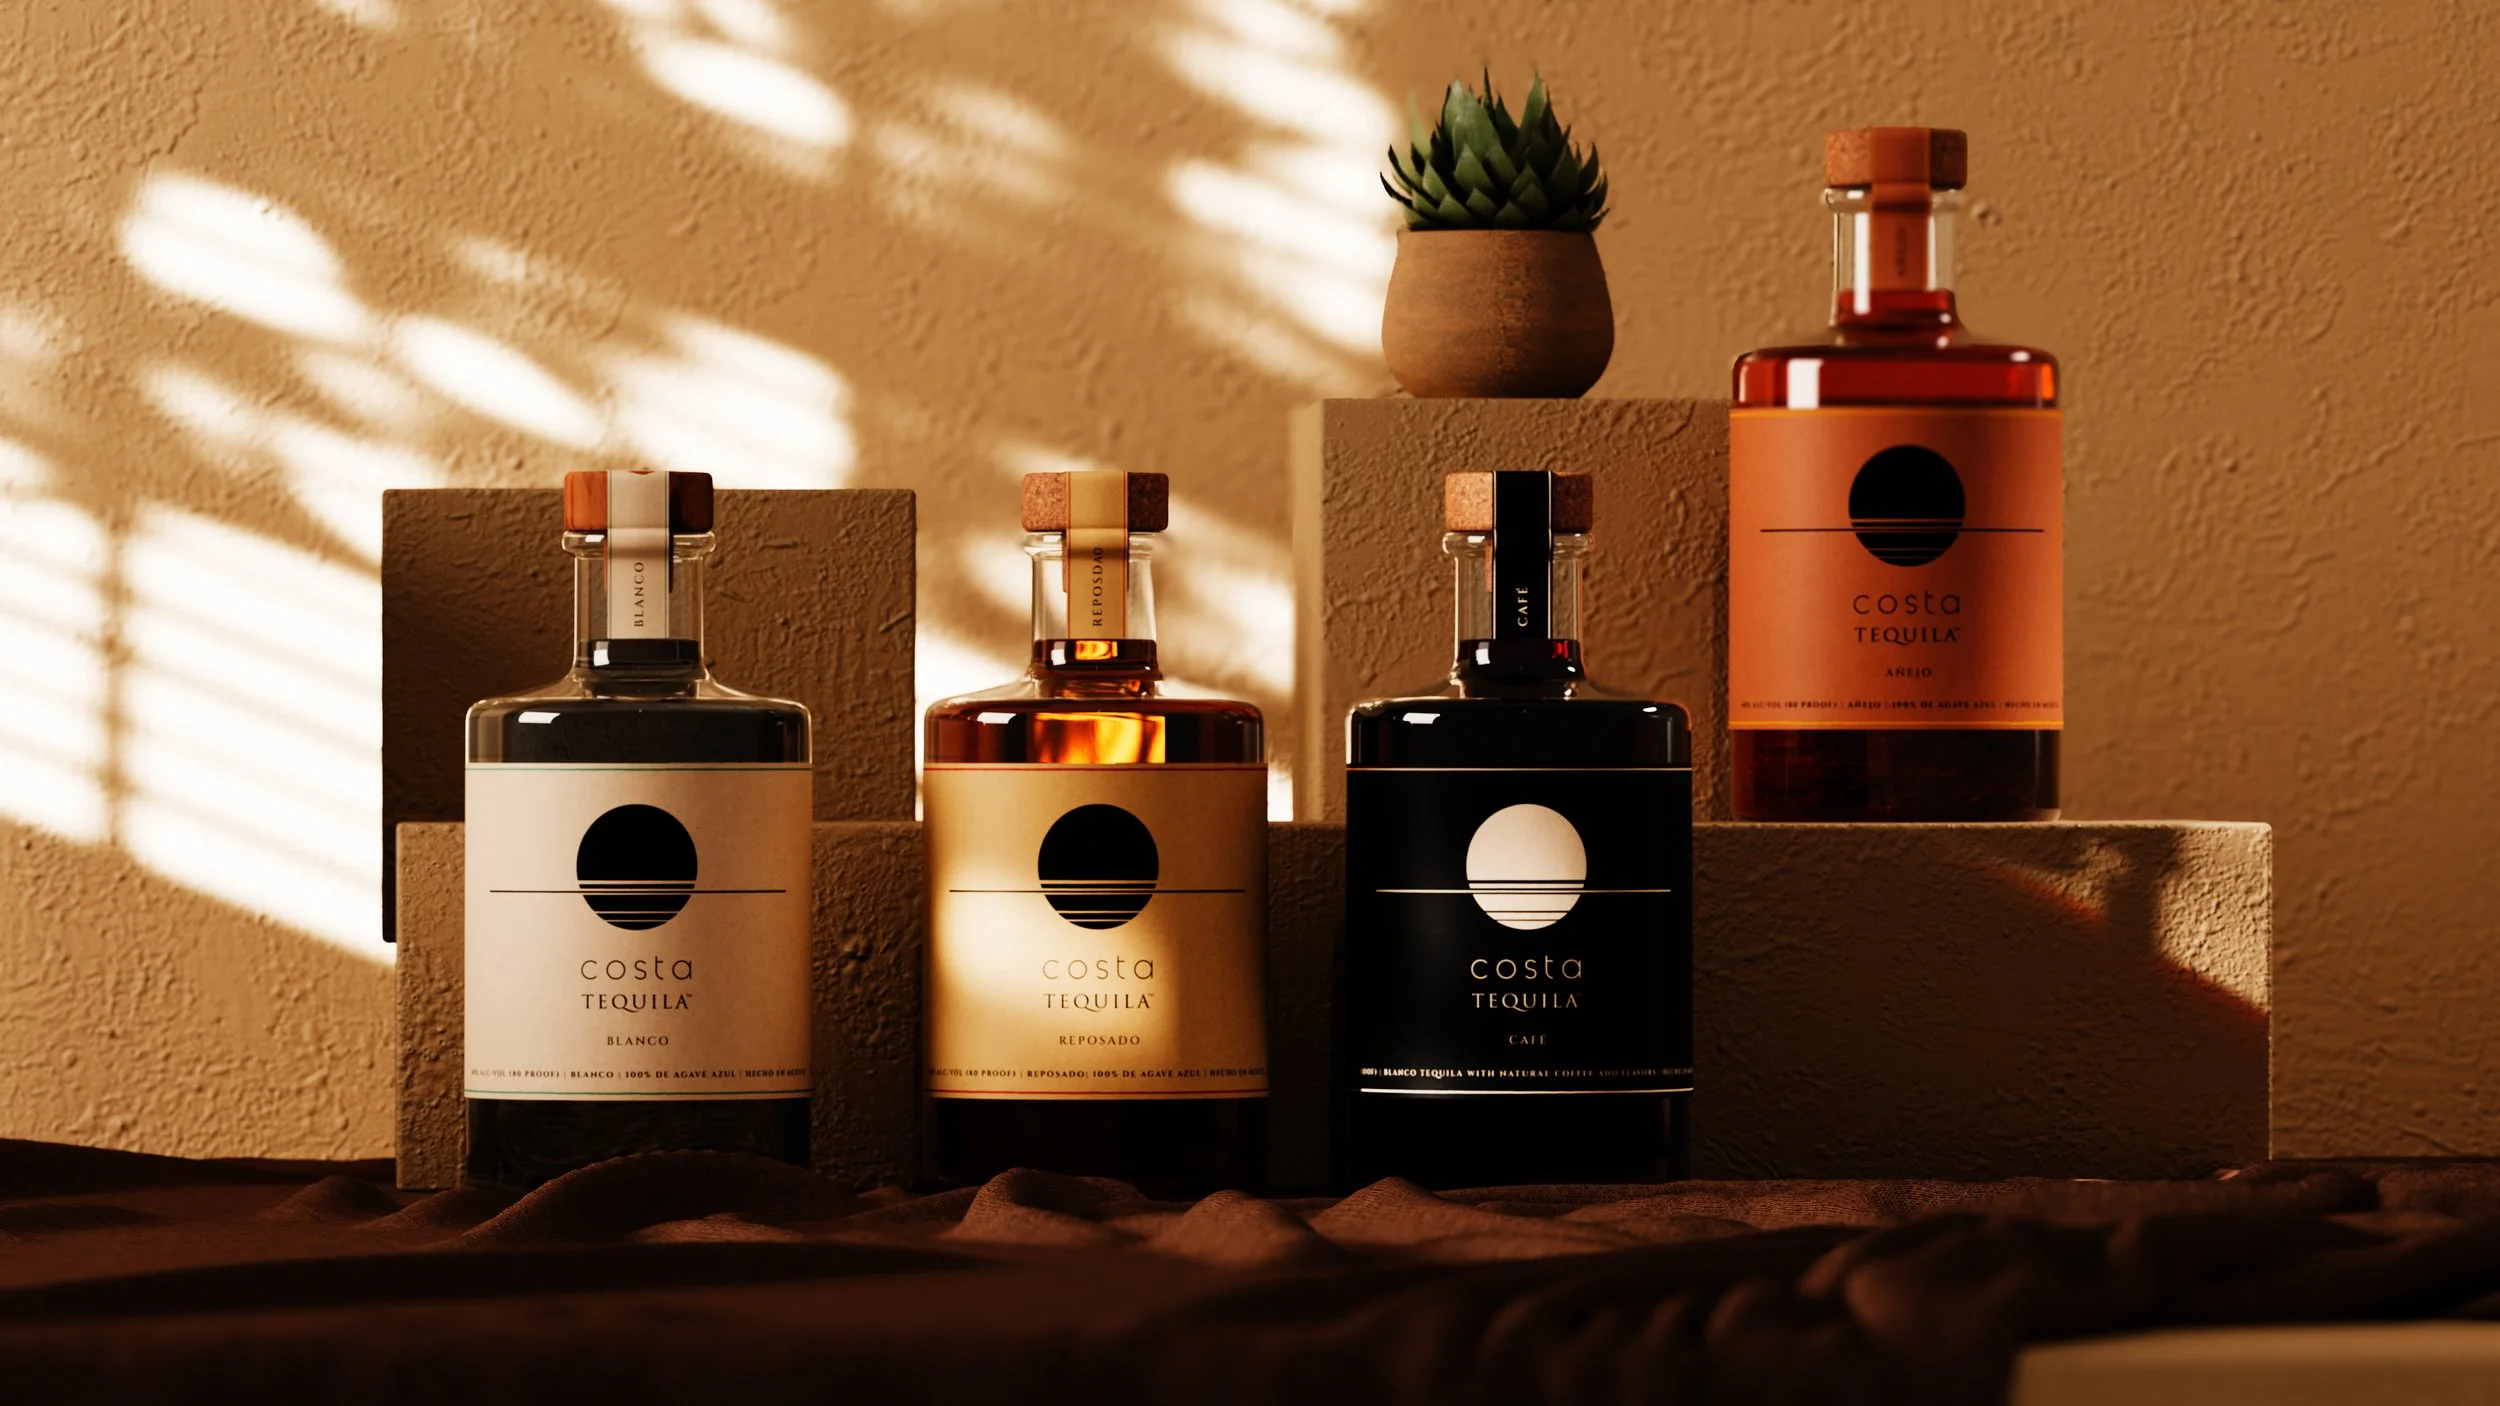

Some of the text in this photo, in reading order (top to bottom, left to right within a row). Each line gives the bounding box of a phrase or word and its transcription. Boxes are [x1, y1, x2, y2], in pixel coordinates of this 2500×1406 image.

[634, 562, 645, 627] BLANCO
[1515, 587, 1528, 627] CAFÉ
[1852, 590, 1960, 615] costa
[1885, 666, 1932, 679] AÑEJO
[581, 955, 692, 980] costa
[1043, 955, 1154, 980] costa
[1470, 955, 1582, 980] costa
[606, 1036, 669, 1046] BLANCO
[1059, 1035, 1141, 1045] REPOSADO
[1509, 1034, 1547, 1045] CAFÉ
[524, 1070, 560, 1078] PROOF)
[711, 1070, 737, 1078] AZUL
[981, 1070, 1016, 1078] PROOF)
[1093, 1070, 1118, 1078] 100%
[1122, 1070, 1137, 1078] DE
[1140, 1070, 1173, 1078] AGAVE
[1383, 1068, 1417, 1077] BLANCO
[1420, 1069, 1463, 1079] TEQUILA
